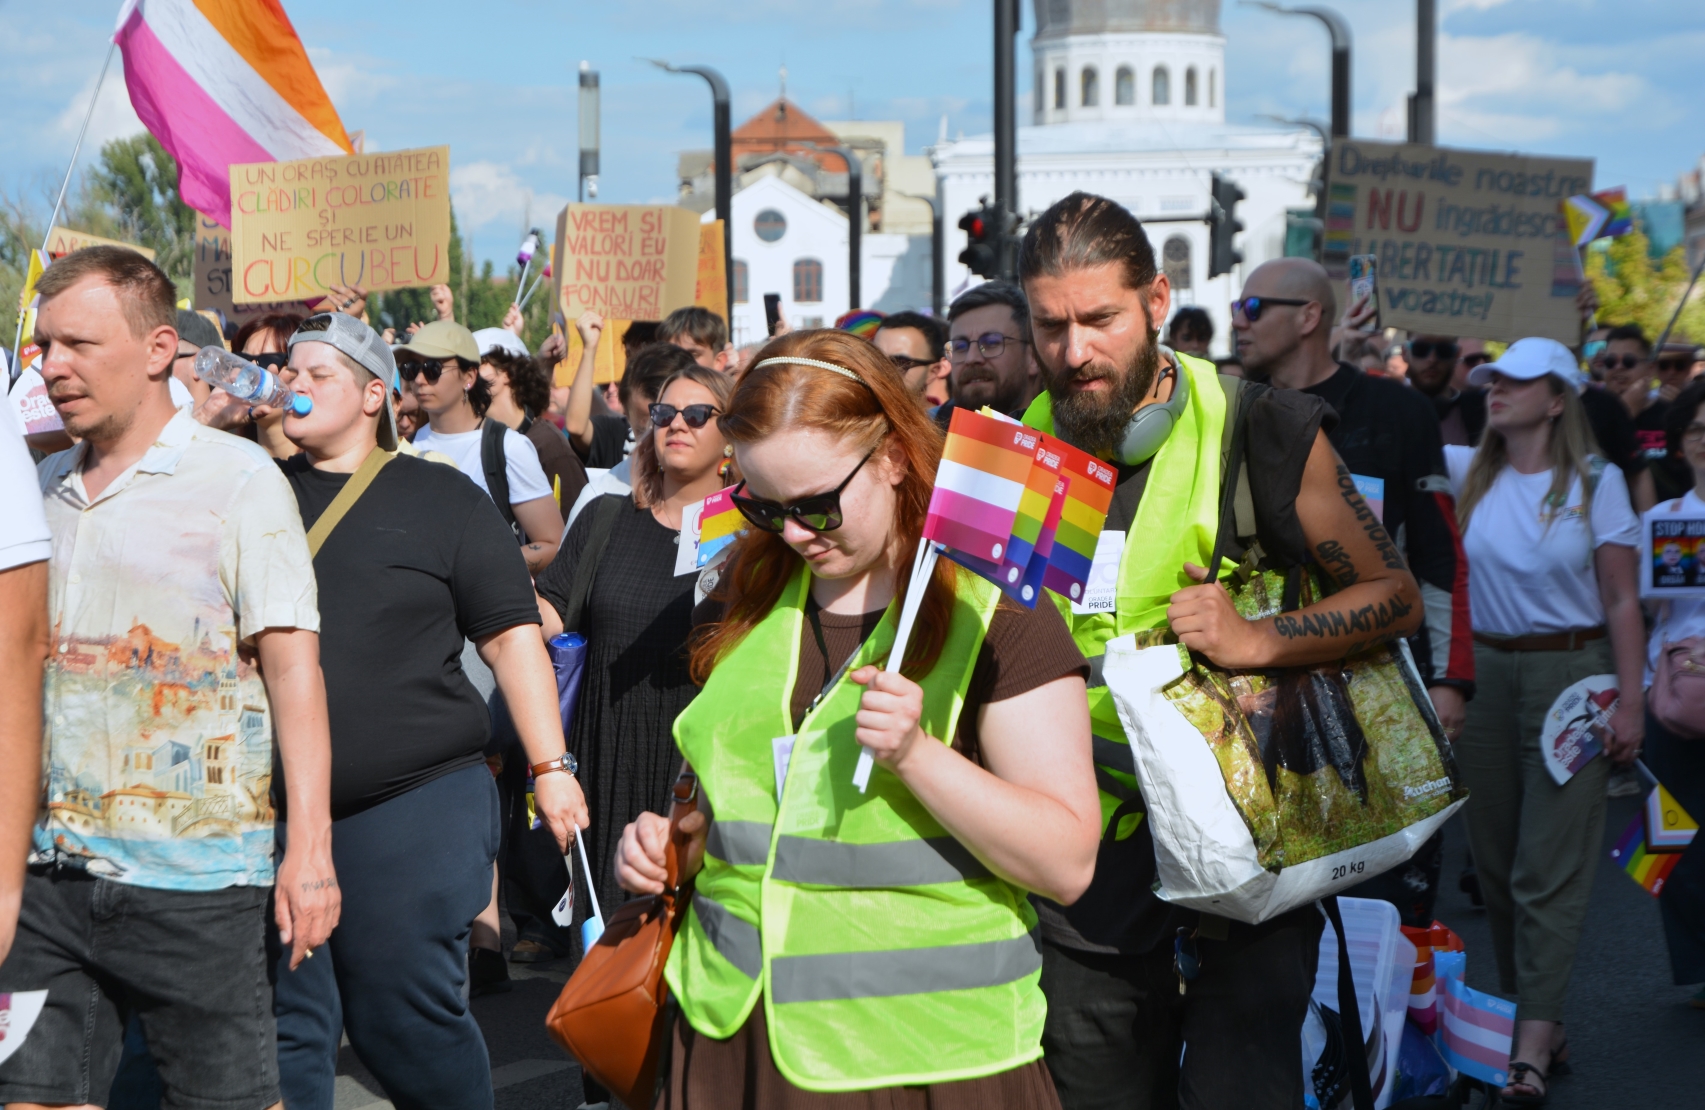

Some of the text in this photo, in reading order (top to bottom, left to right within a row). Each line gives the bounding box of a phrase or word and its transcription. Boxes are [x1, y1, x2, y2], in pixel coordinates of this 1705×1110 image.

[246, 152, 440, 185] UN ORAȘ CU ATÂTEA
[1340, 145, 1587, 198] Drepturile noastre
[237, 175, 438, 214] CLĂDIRI COLORATE
[318, 209, 336, 227] ȘI
[570, 210, 628, 233] VREM
[1367, 187, 1425, 233] NU
[262, 222, 412, 253] NE SPERIE UN
[567, 231, 666, 257] VALORI EU
[243, 244, 438, 297] CURCUBEU
[575, 258, 666, 282] NU DOAR
[562, 281, 661, 307] FONDURI
[1384, 286, 1495, 320] voastre!
[584, 306, 661, 320] UROPENE
[1656, 521, 1685, 536] STOP
[1089, 601, 1113, 609] PRIDE
[1273, 593, 1413, 640] GRAMMATICAL
[1553, 725, 1587, 760] Oradea
[796, 816, 820, 827] PRIDE
[1332, 860, 1366, 881] 20 kg
